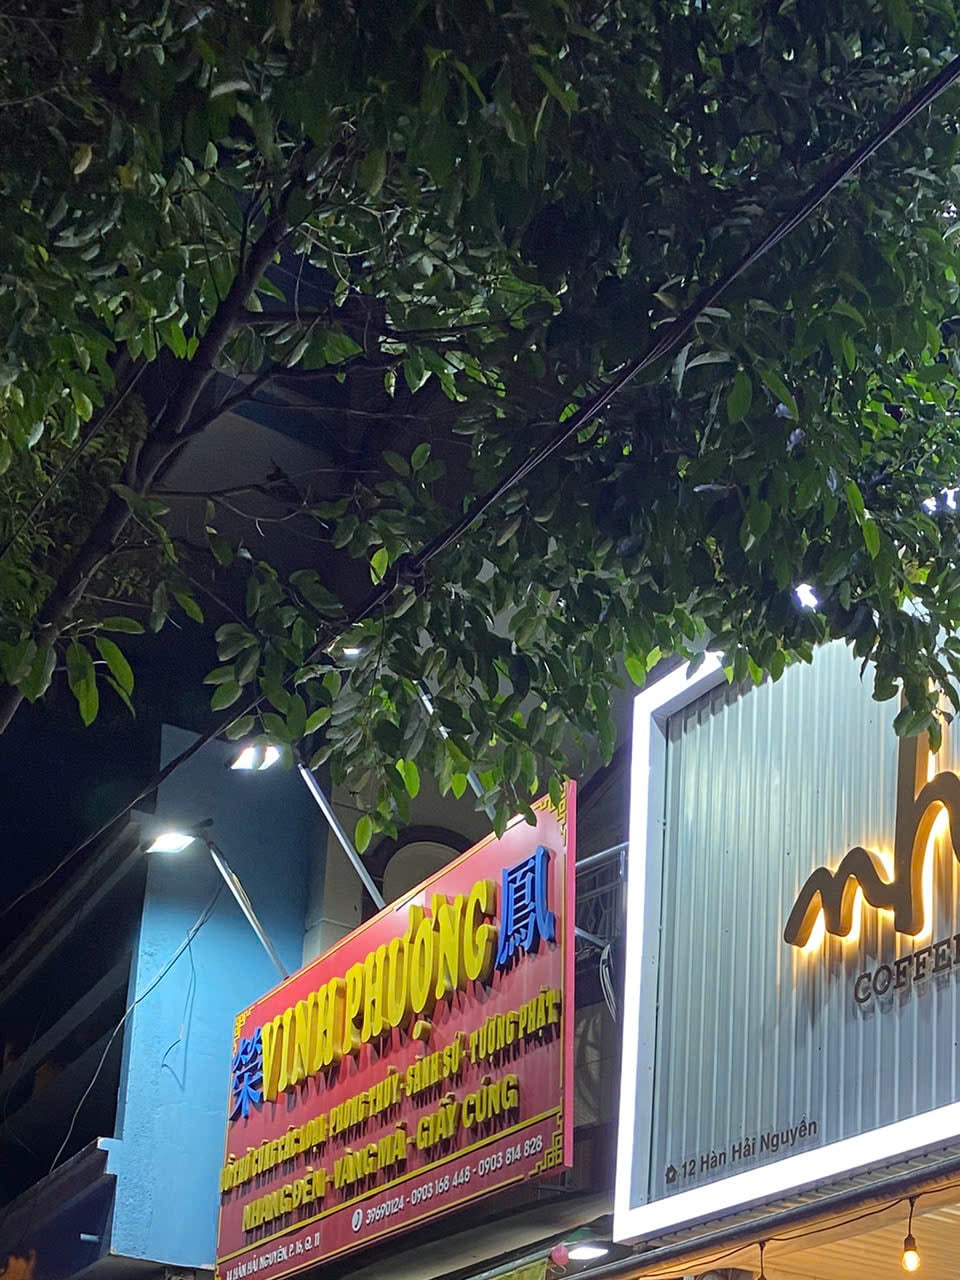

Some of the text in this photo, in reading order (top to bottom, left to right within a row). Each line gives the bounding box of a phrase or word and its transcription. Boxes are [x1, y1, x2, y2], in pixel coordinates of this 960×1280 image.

[343, 879, 498, 1053] PHƯỢNG
[242, 1184, 293, 1232] NHANG
[333, 1143, 378, 1189] VÀNG
[462, 1073, 521, 1129] CÚNG
[366, 1194, 404, 1225] 39690124
[410, 1182, 433, 1206] 0903
[435, 1175, 450, 1196] 168
[451, 1165, 471, 1187] 448
[478, 1156, 503, 1178] 0903
[505, 1145, 521, 1166] 814
[523, 1135, 543, 1157] 828
[682, 1159, 697, 1178] 12
[700, 1151, 727, 1173] Hàn
[732, 1137, 756, 1162] Hải
